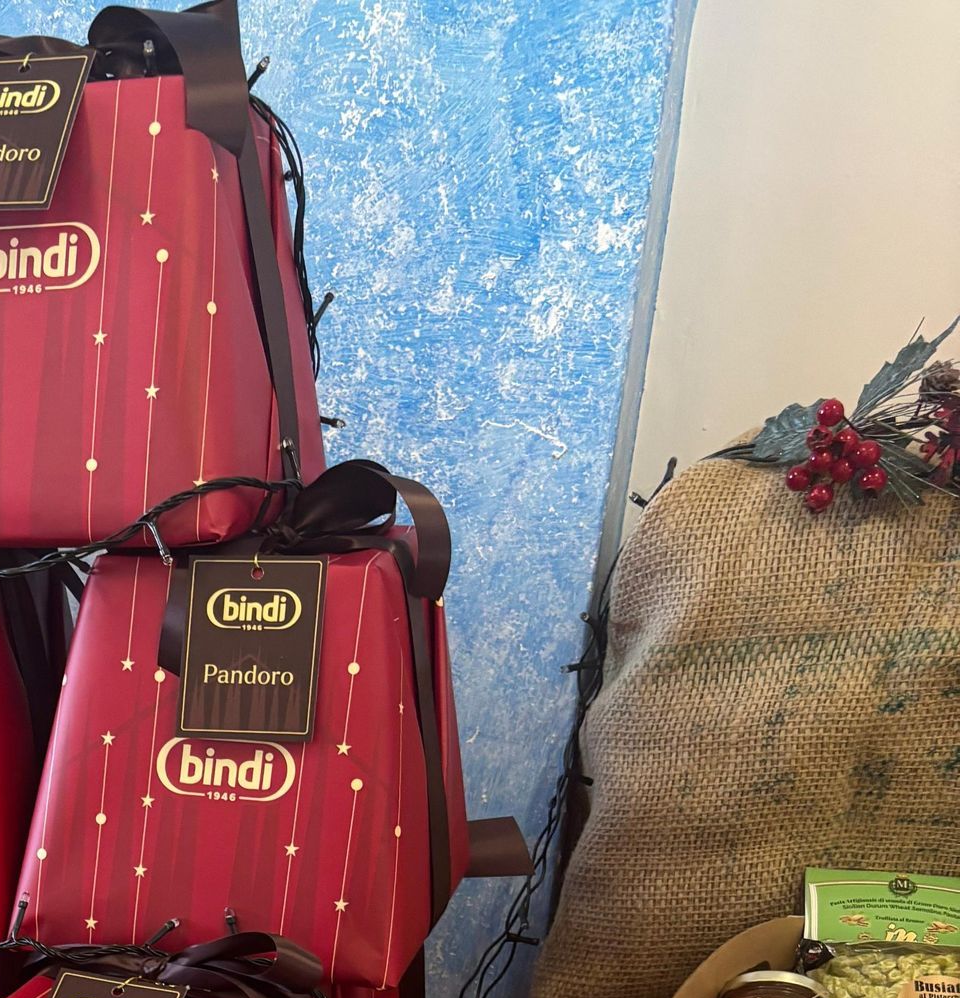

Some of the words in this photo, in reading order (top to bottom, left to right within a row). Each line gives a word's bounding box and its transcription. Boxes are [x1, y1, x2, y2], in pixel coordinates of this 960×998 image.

[12, 284, 42, 294] 1946
[223, 594, 287, 623] bindi
[203, 663, 294, 686] Pandoro
[179, 743, 274, 791] bindi
[206, 791, 237, 802] 1946
